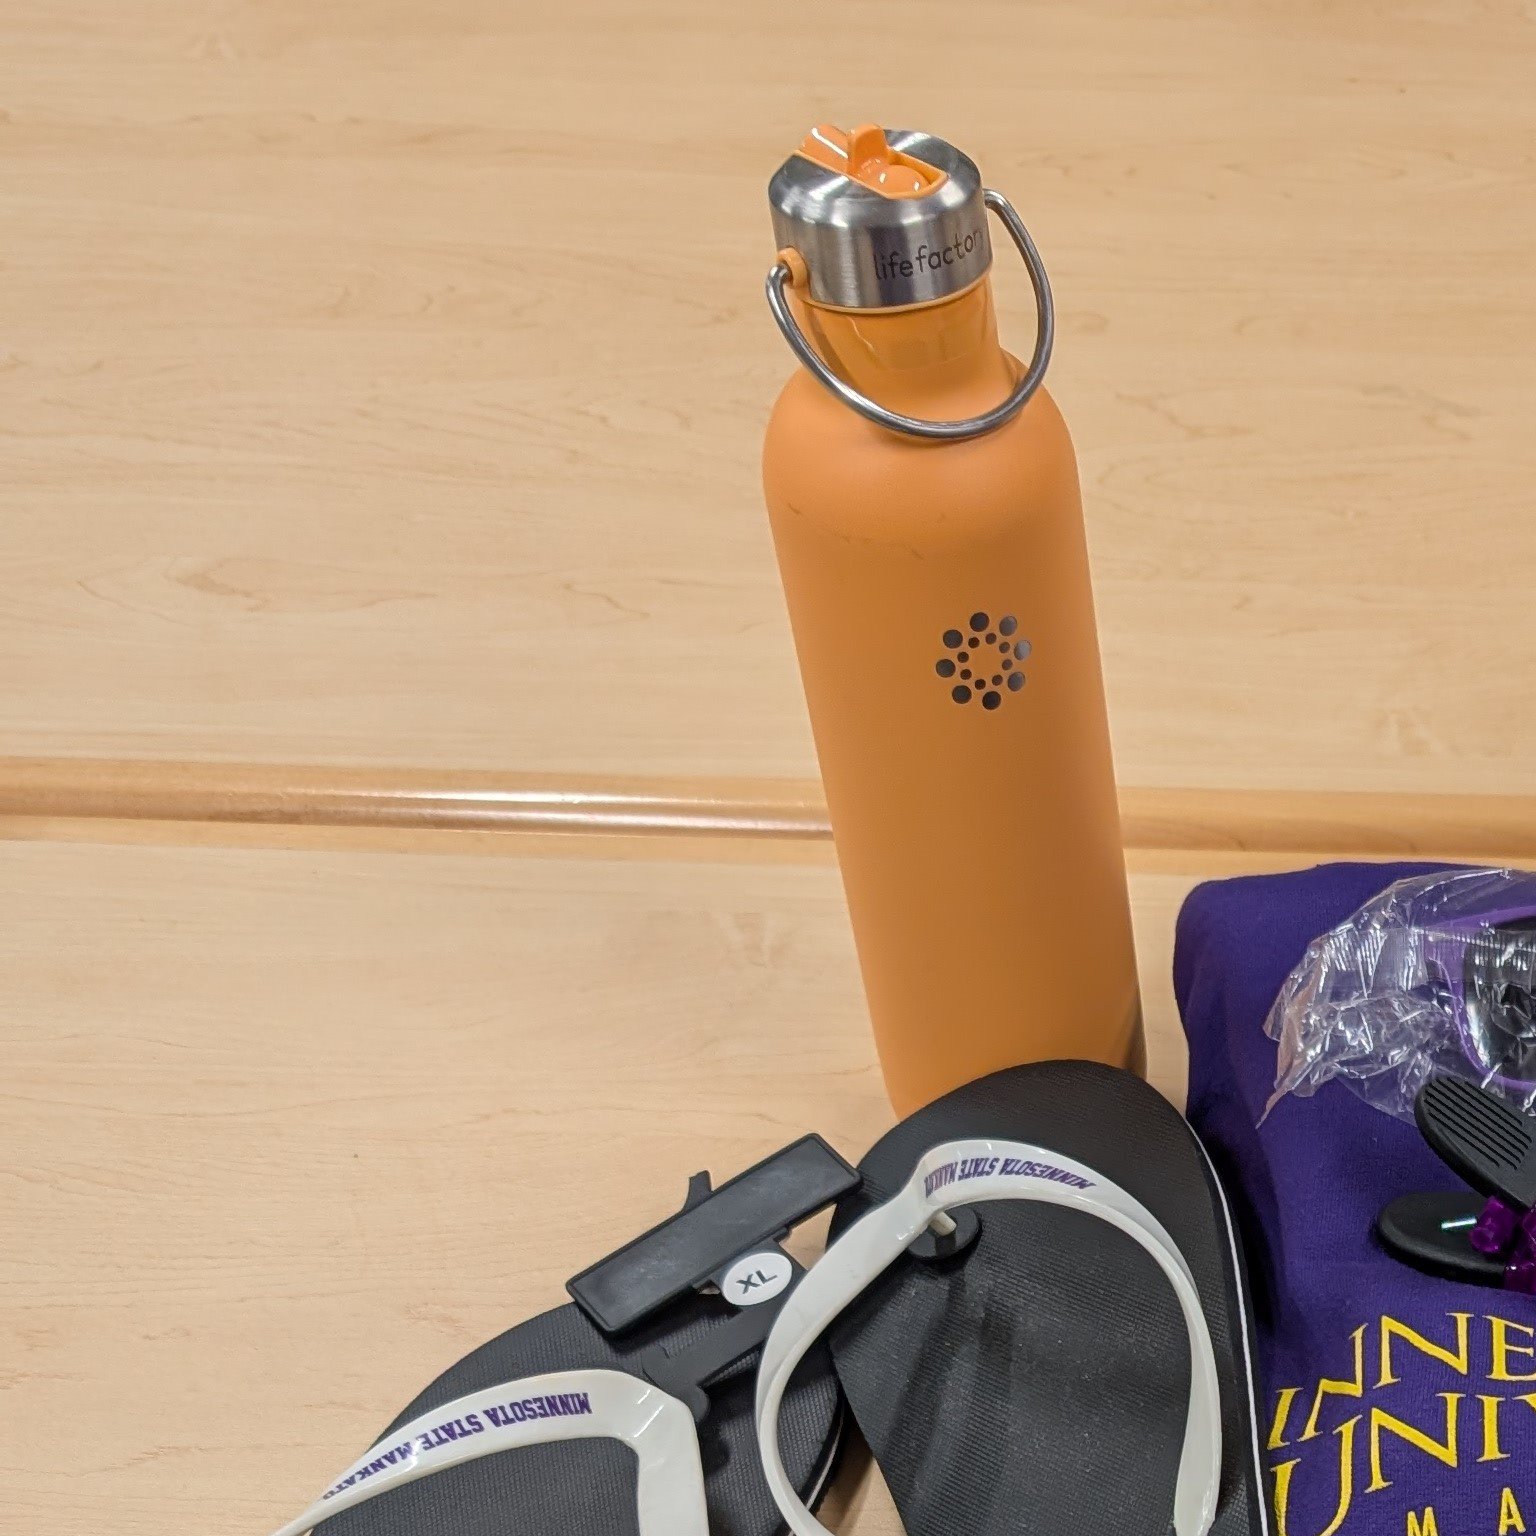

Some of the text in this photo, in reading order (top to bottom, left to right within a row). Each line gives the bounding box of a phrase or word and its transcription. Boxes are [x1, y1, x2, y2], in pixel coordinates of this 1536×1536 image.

[957, 1157, 1000, 1182] STATE
[998, 1157, 1097, 1190] MINNESOTA
[736, 1269, 778, 1294] XL
[483, 1392, 593, 1428] MINNESOTA
[416, 1413, 485, 1451] STATE
